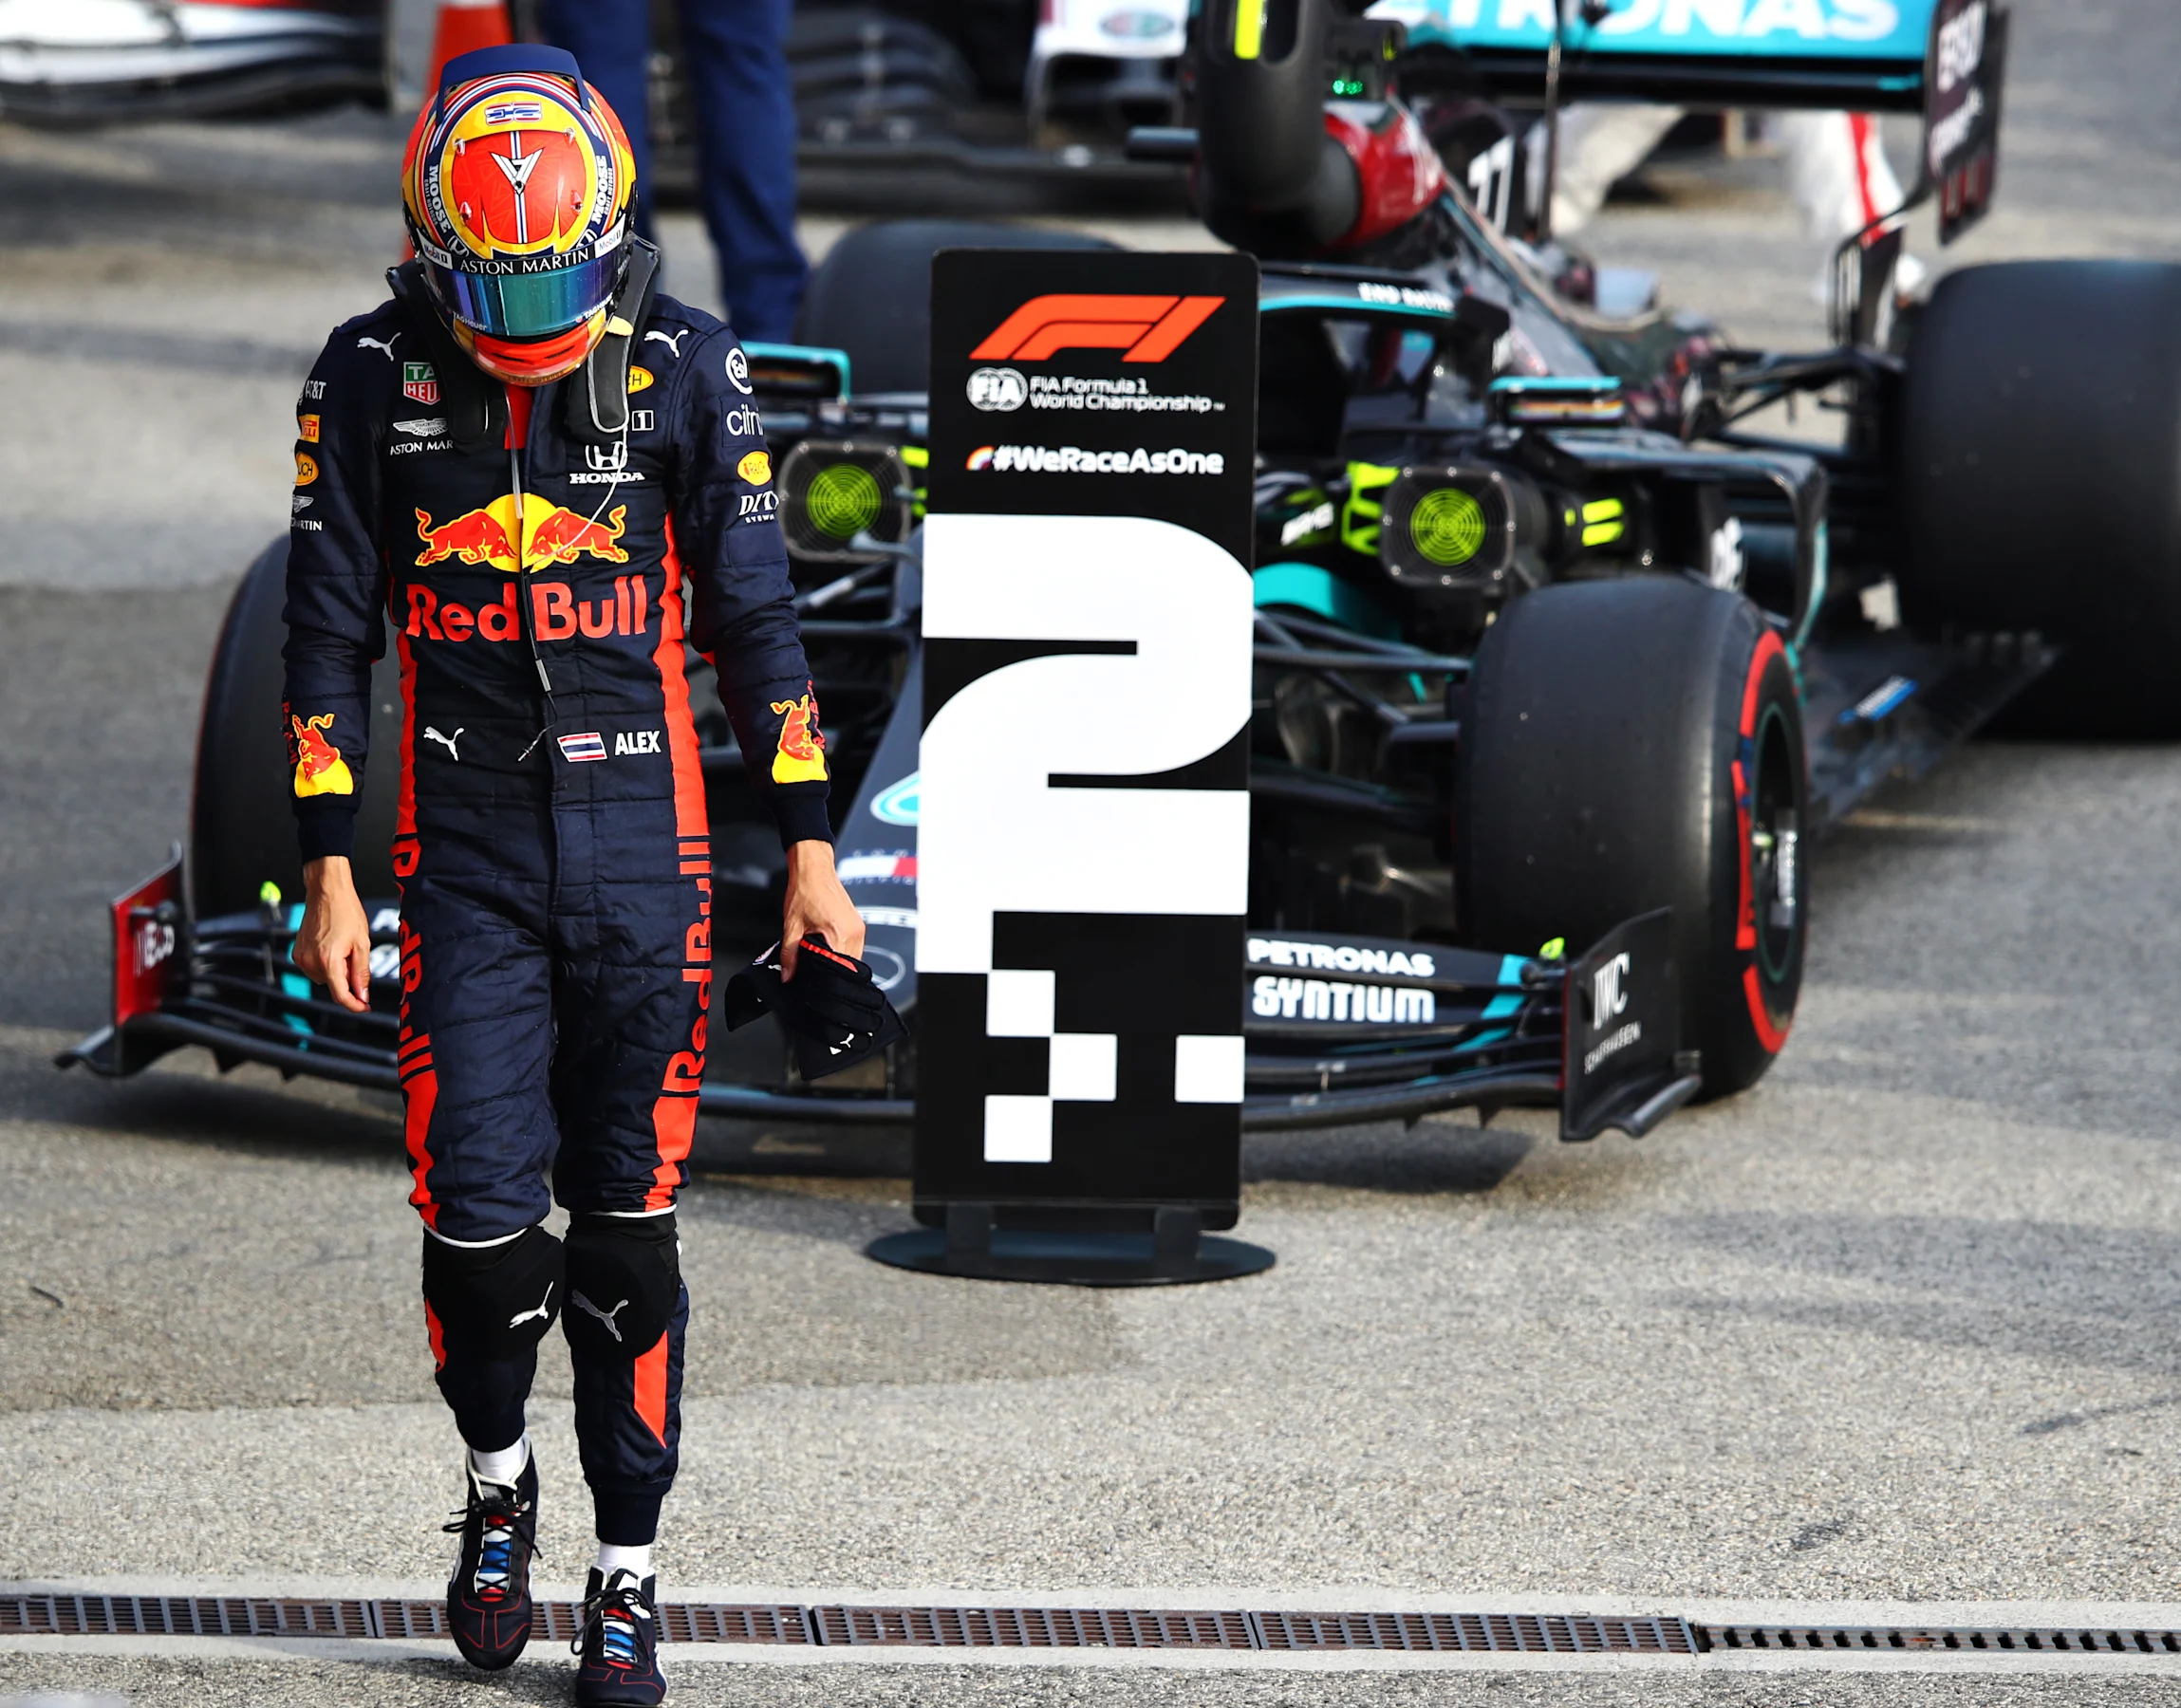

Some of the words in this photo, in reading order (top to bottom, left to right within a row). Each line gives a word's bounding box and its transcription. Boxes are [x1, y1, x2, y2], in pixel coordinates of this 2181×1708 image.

[428, 164, 452, 233] MOOSE
[591, 156, 608, 225] MOOSE
[459, 259, 519, 274] ASTON
[522, 249, 589, 274] MARTIN
[408, 365, 435, 380] TA
[305, 380, 327, 400] AT&T
[407, 383, 438, 402] HEU
[1030, 376, 1061, 393] FIA
[1063, 377, 1137, 395] Formula
[1138, 378, 1149, 395] 1
[1030, 393, 1085, 410] World
[1085, 394, 1213, 414] Championship
[390, 441, 423, 455] ASTON
[426, 439, 454, 451] MAR
[993, 444, 1225, 474] #WeRaceAsOne
[569, 473, 645, 484] HONDA
[406, 582, 520, 642] Red
[531, 574, 647, 642] Bull
[915, 513, 1253, 915] 2
[615, 731, 662, 755] ALEX
[1247, 938, 1435, 977] PETRONAS
[1252, 975, 1435, 1024] SYNTIUM
[1594, 952, 1630, 1030] IWC
